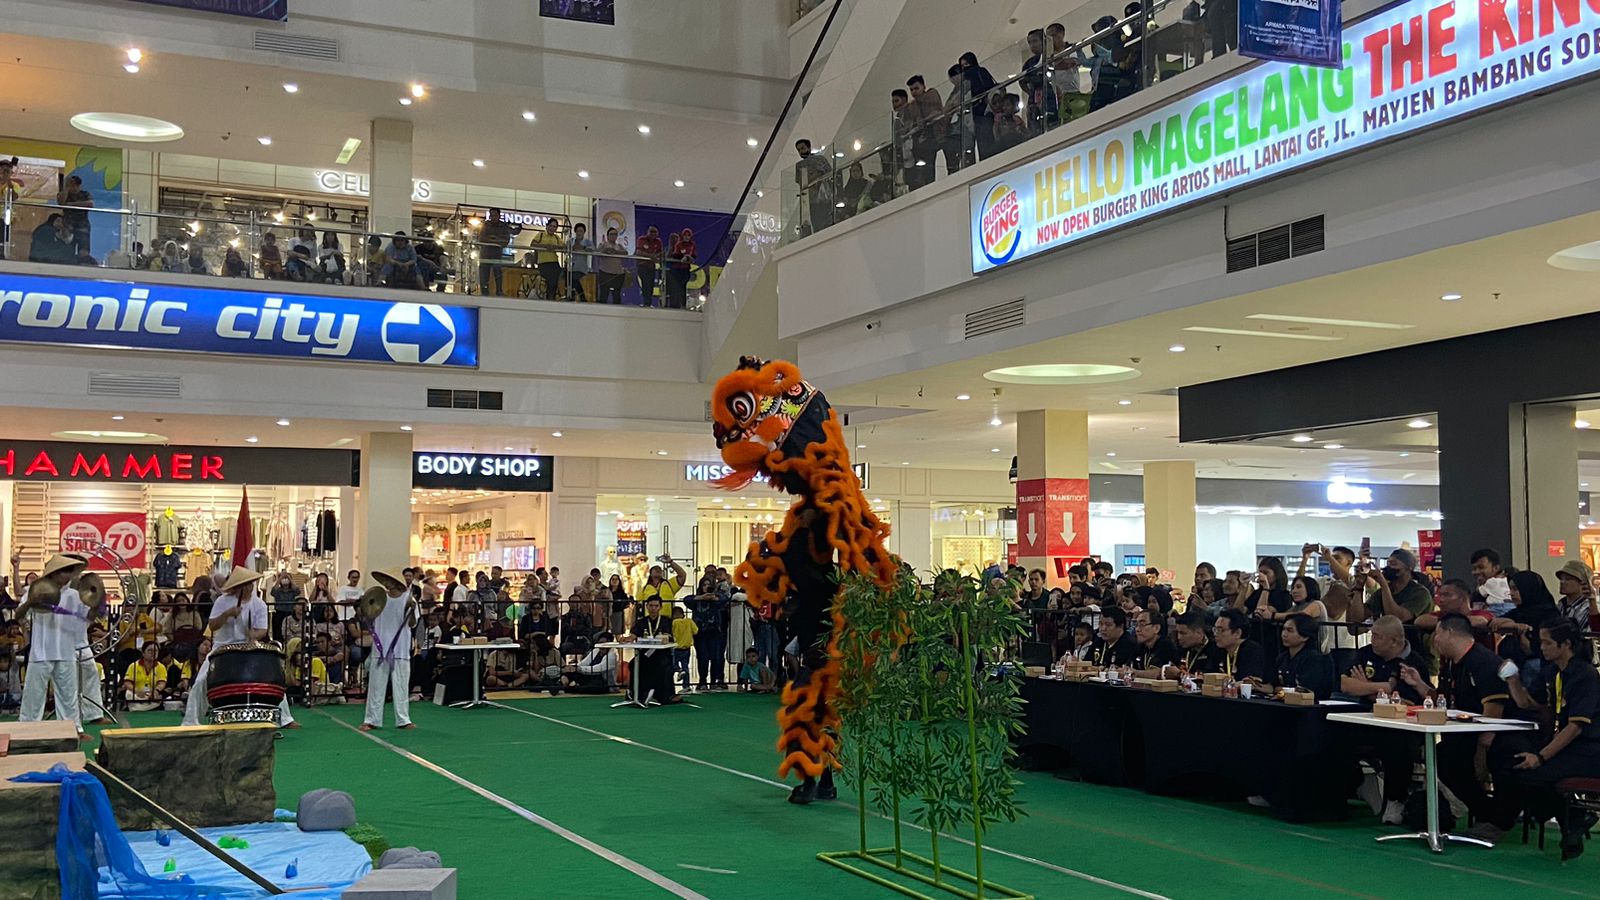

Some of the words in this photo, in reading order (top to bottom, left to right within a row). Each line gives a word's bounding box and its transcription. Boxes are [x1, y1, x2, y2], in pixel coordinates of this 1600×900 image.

[1034, 139, 1124, 222] HELLO
[1133, 43, 1353, 186] MAGELANG
[1363, 3, 1457, 98] THE
[1479, 0, 1600, 59] KI
[1037, 221, 1060, 244] NOW
[1063, 210, 1089, 235] OPEN
[1093, 194, 1137, 225] BURGER
[1140, 182, 1168, 209] KING
[1172, 167, 1210, 198] ARTOS
[1213, 155, 1250, 184] MALL,
[1255, 134, 1302, 170] LANTAI
[1307, 126, 1329, 149] GF,
[1334, 118, 1355, 143] JL.
[1363, 87, 1434, 132] MAYJEN
[1444, 45, 1551, 105] BAMBANG
[984, 190, 1017, 232] BURGER
[986, 204, 1019, 253] KING
[216, 298, 360, 356] city
[418, 455, 476, 474] BODY
[480, 457, 541, 477] SHOP.
[65, 539, 97, 551] SALE
[109, 533, 138, 550] 70
